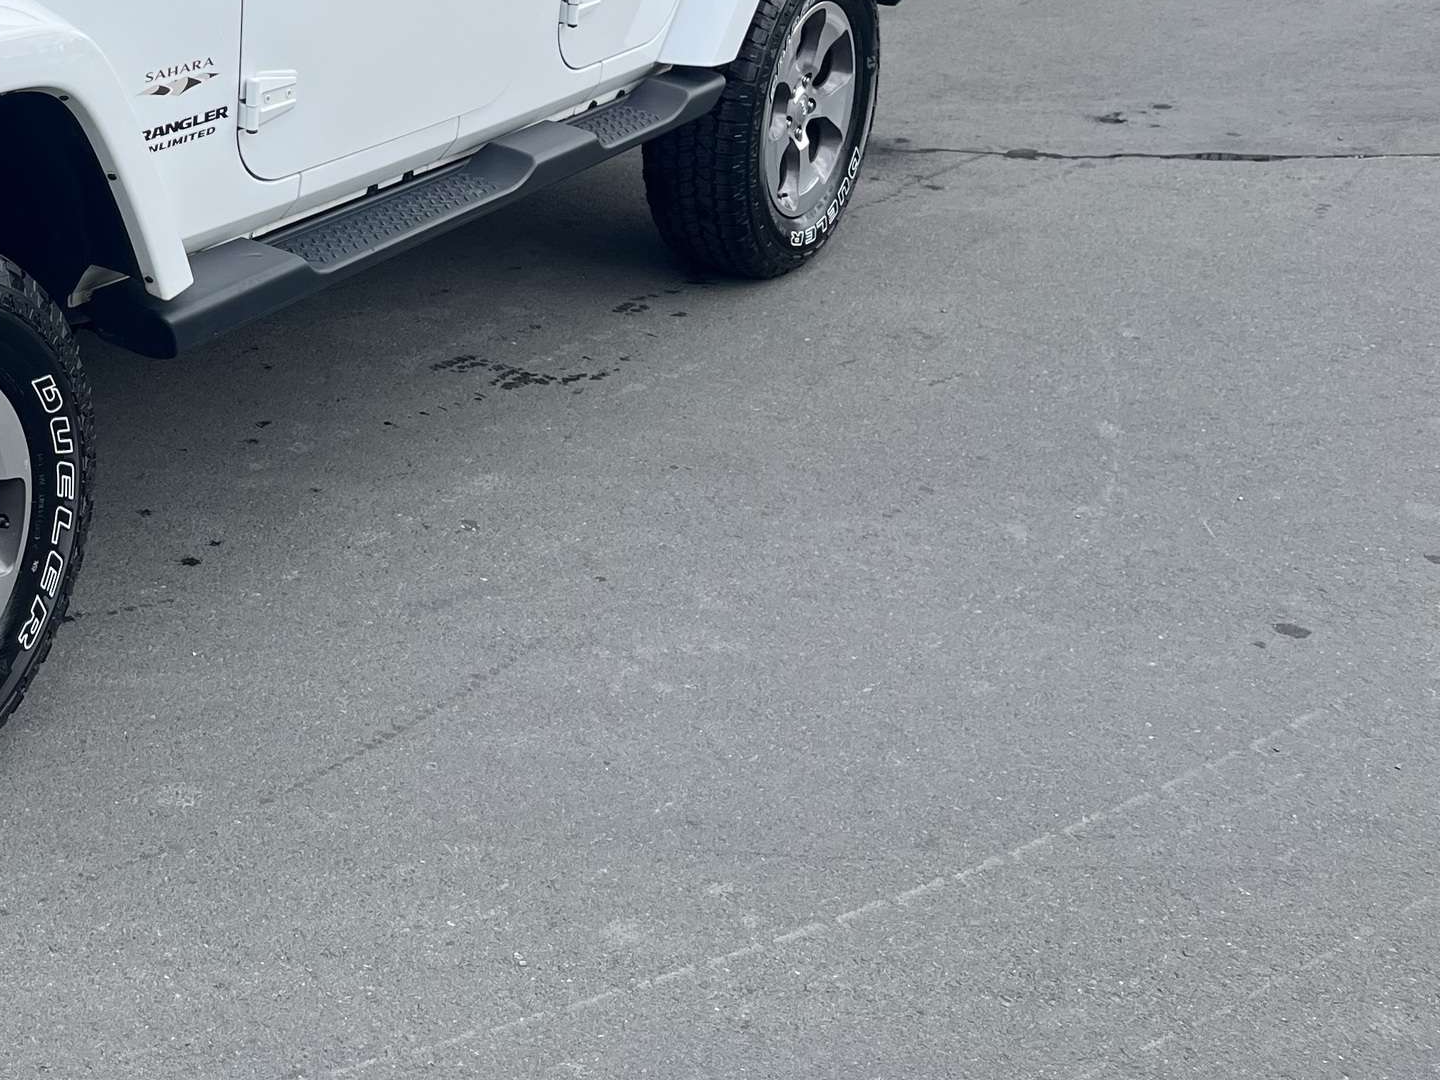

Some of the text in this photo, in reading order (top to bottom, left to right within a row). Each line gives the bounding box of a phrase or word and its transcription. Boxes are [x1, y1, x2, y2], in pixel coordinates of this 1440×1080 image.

[145, 57, 214, 83] SAHARA
[142, 106, 229, 141] RANGLER
[148, 126, 216, 153] NLIMITED
[791, 146, 861, 246] DUELER
[18, 374, 74, 650] DUELER
